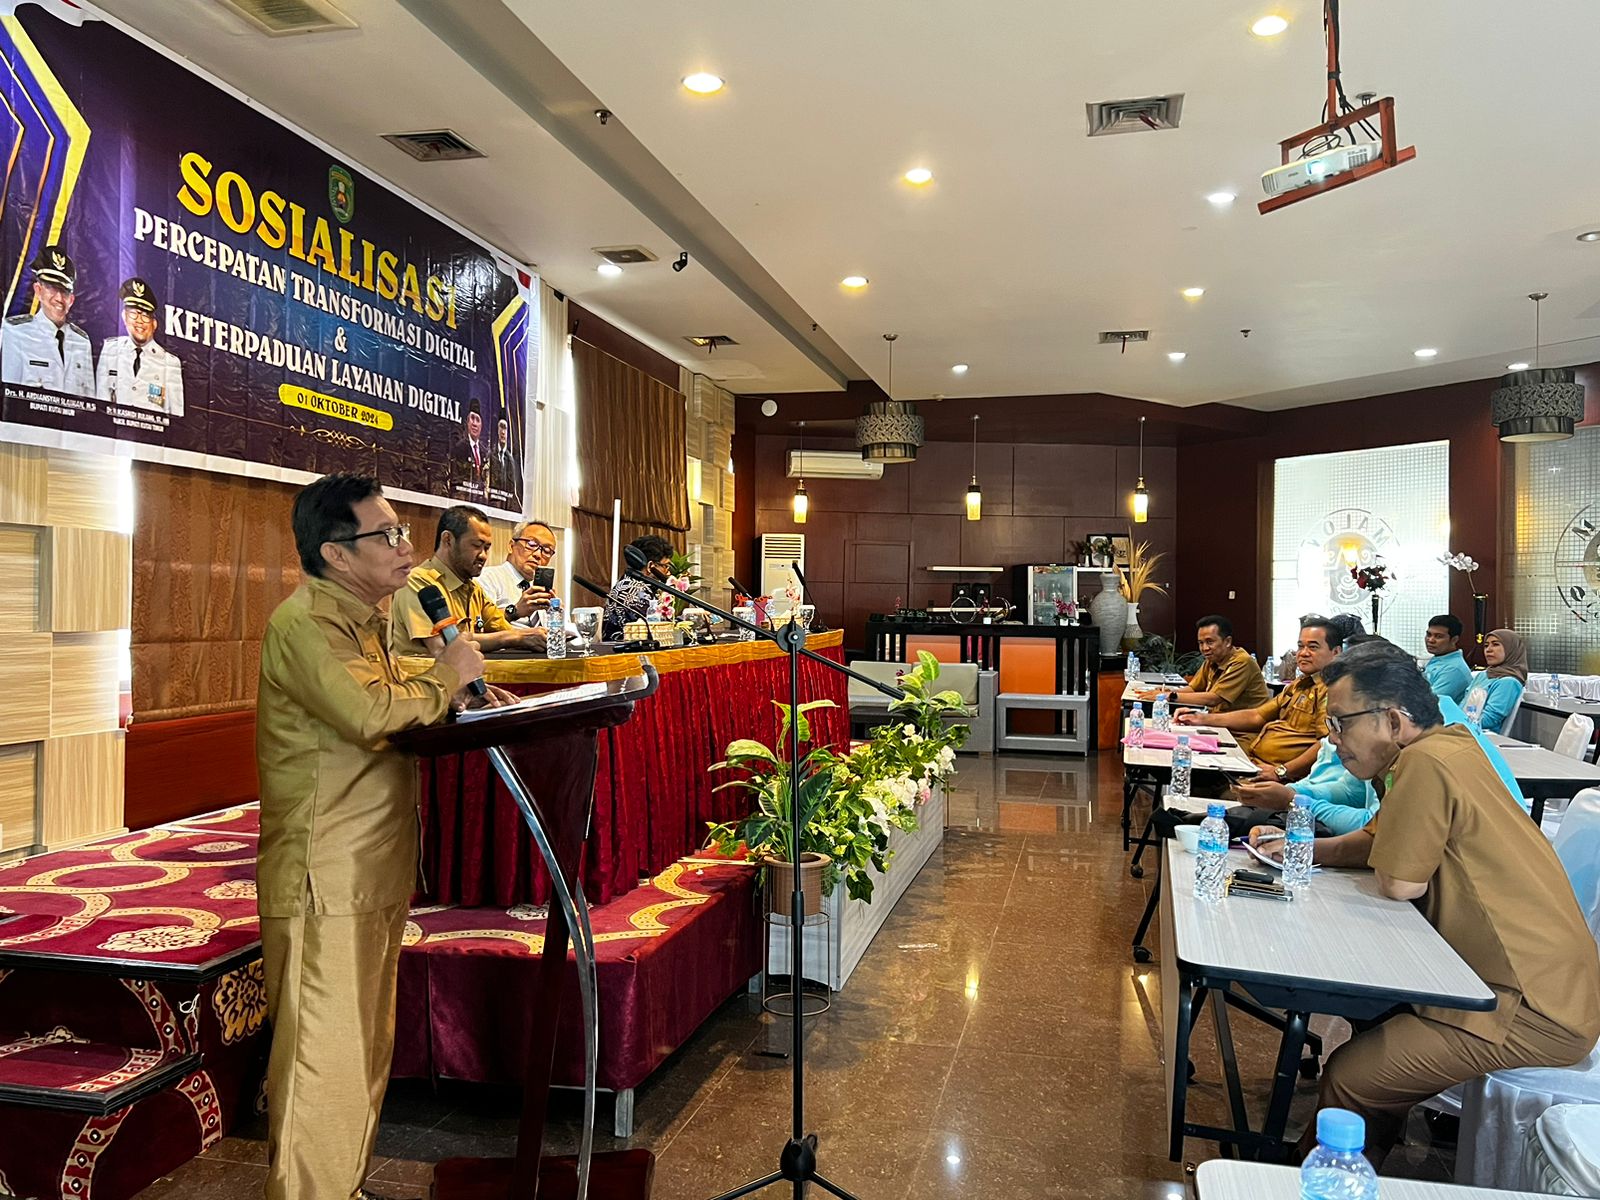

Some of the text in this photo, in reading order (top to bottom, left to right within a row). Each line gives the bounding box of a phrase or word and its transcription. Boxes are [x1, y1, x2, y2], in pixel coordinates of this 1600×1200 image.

[133, 207, 477, 373] PERCEPATAN TRANSFORMASI DIGITAL
[176, 152, 457, 330] SOSIALISASI
[164, 304, 462, 424] KETERPADUAN LAYANAN DIGITAL
[334, 326, 347, 353] &
[297, 392, 379, 424] 01 OKTOBER 2024
